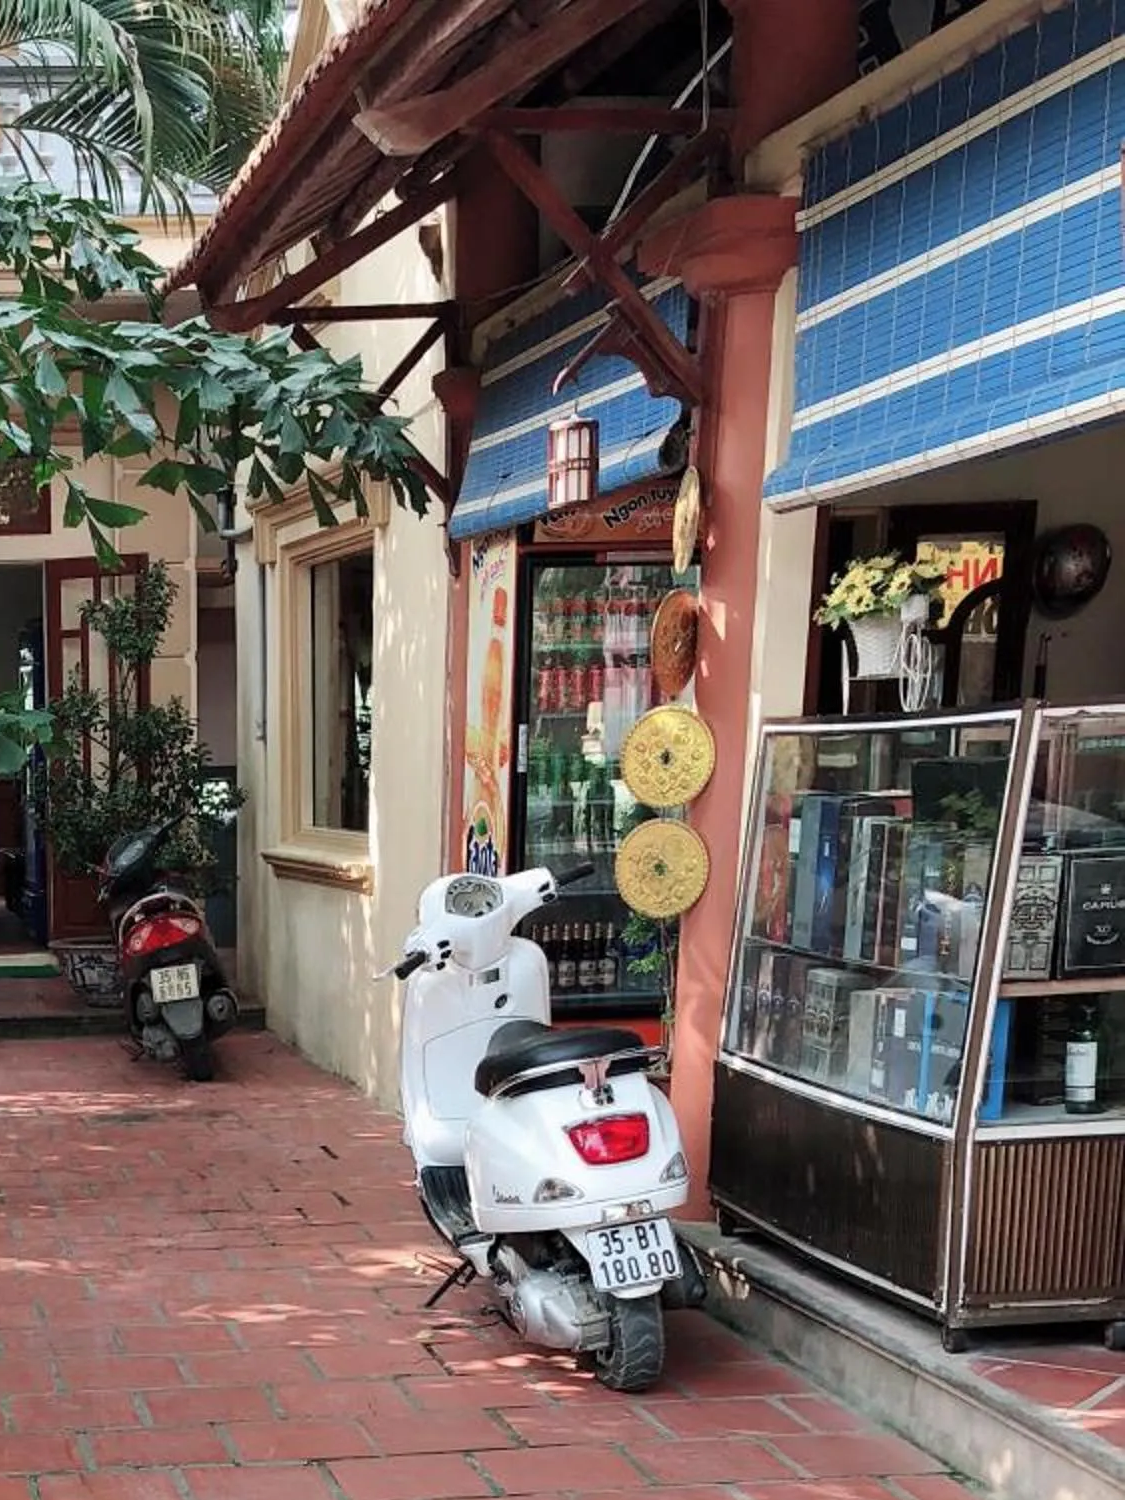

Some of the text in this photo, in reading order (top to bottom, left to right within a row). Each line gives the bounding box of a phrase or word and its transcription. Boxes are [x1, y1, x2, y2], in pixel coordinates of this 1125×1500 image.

[603, 495, 648, 528] Ngon
[650, 487, 679, 502] tuy
[598, 1222, 662, 1257] 35-B1
[599, 1249, 676, 1286] 180.80
